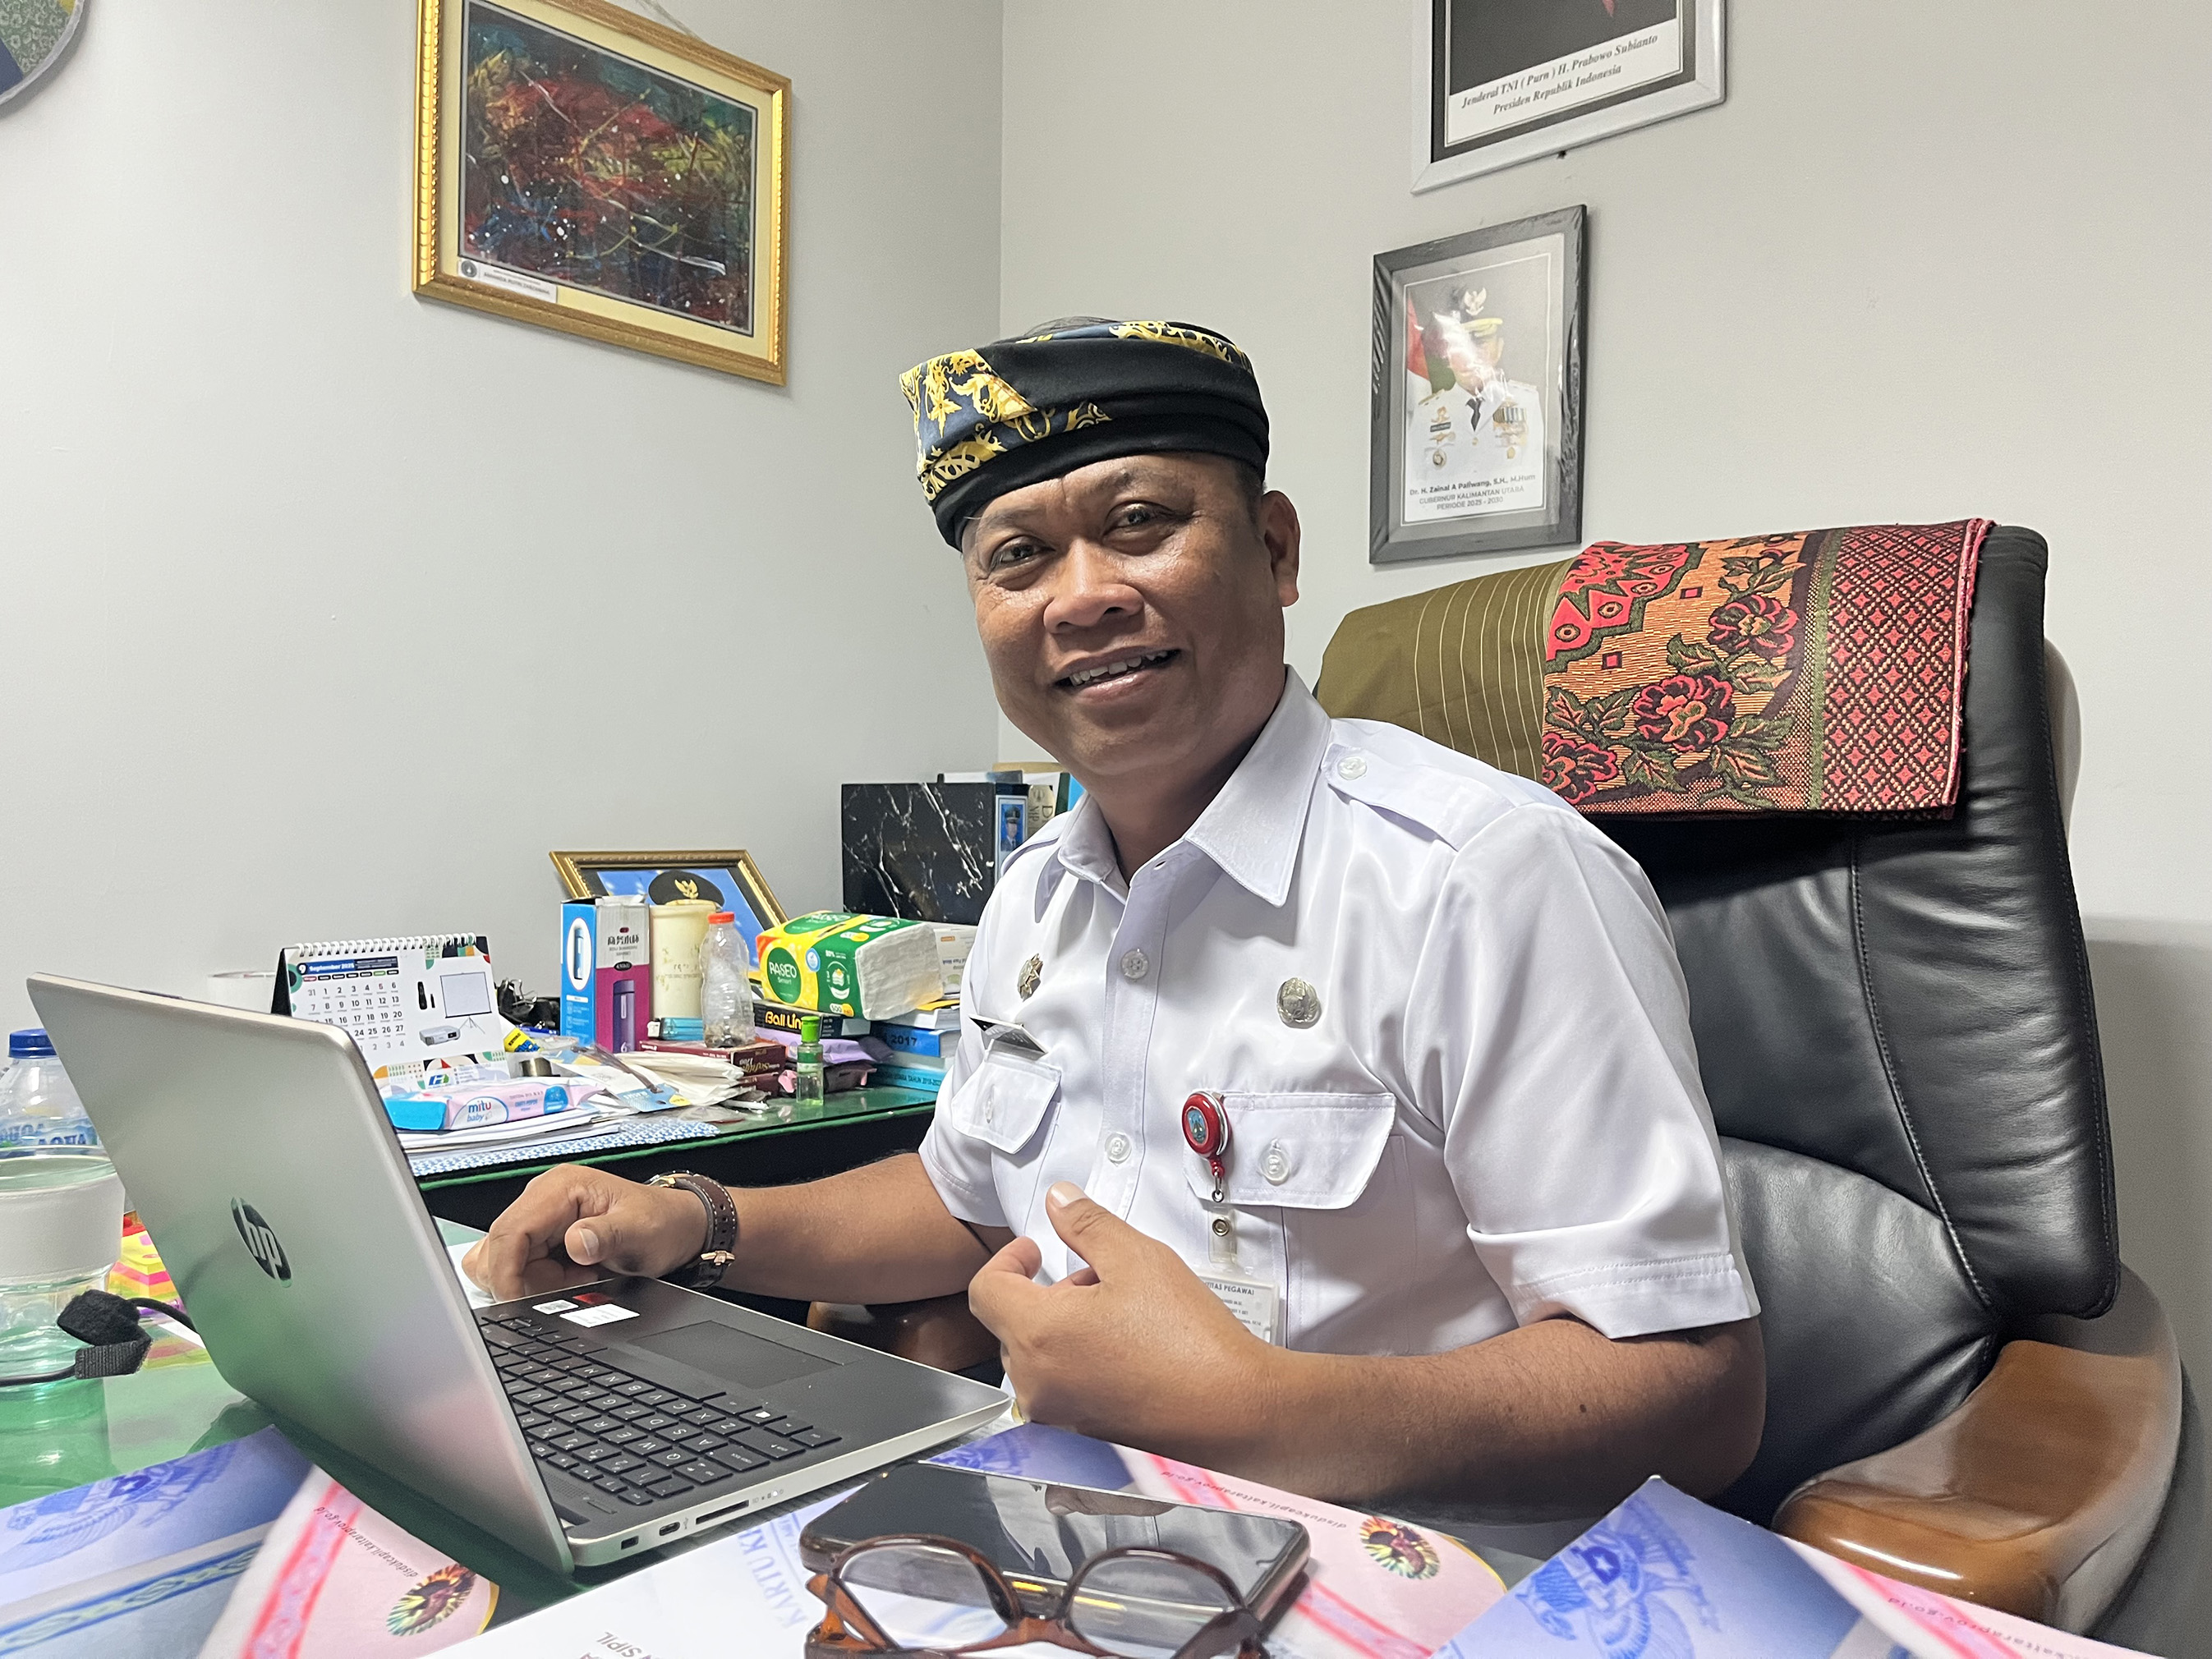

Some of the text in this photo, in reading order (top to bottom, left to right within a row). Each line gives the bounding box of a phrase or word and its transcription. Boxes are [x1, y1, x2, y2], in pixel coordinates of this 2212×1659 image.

[1461, 85, 1499, 108] Jenderal
[1501, 80, 1519, 94] TNI
[1527, 72, 1549, 86] Purn
[1557, 63, 1570, 76] H.
[1571, 50, 1612, 71] Prabowo
[1614, 34, 1658, 56] Subianto
[1493, 64, 1621, 115] Presiden Republik Indonesia
[1429, 485, 1450, 493] Zainal
[1419, 485, 1524, 505] GUBERNUR KALIMANTAN UTARA
[1437, 502, 1465, 510] PERIODE
[309, 963, 342, 972] September
[766, 1011, 802, 1030] Ball Lin
[891, 1036, 918, 1047] 2017
[468, 1101, 492, 1113] mitu
[467, 1113, 485, 1122] baby
[1224, 1284, 1254, 1295] PEGAWAI
[596, 1631, 642, 1658] SIPIL
